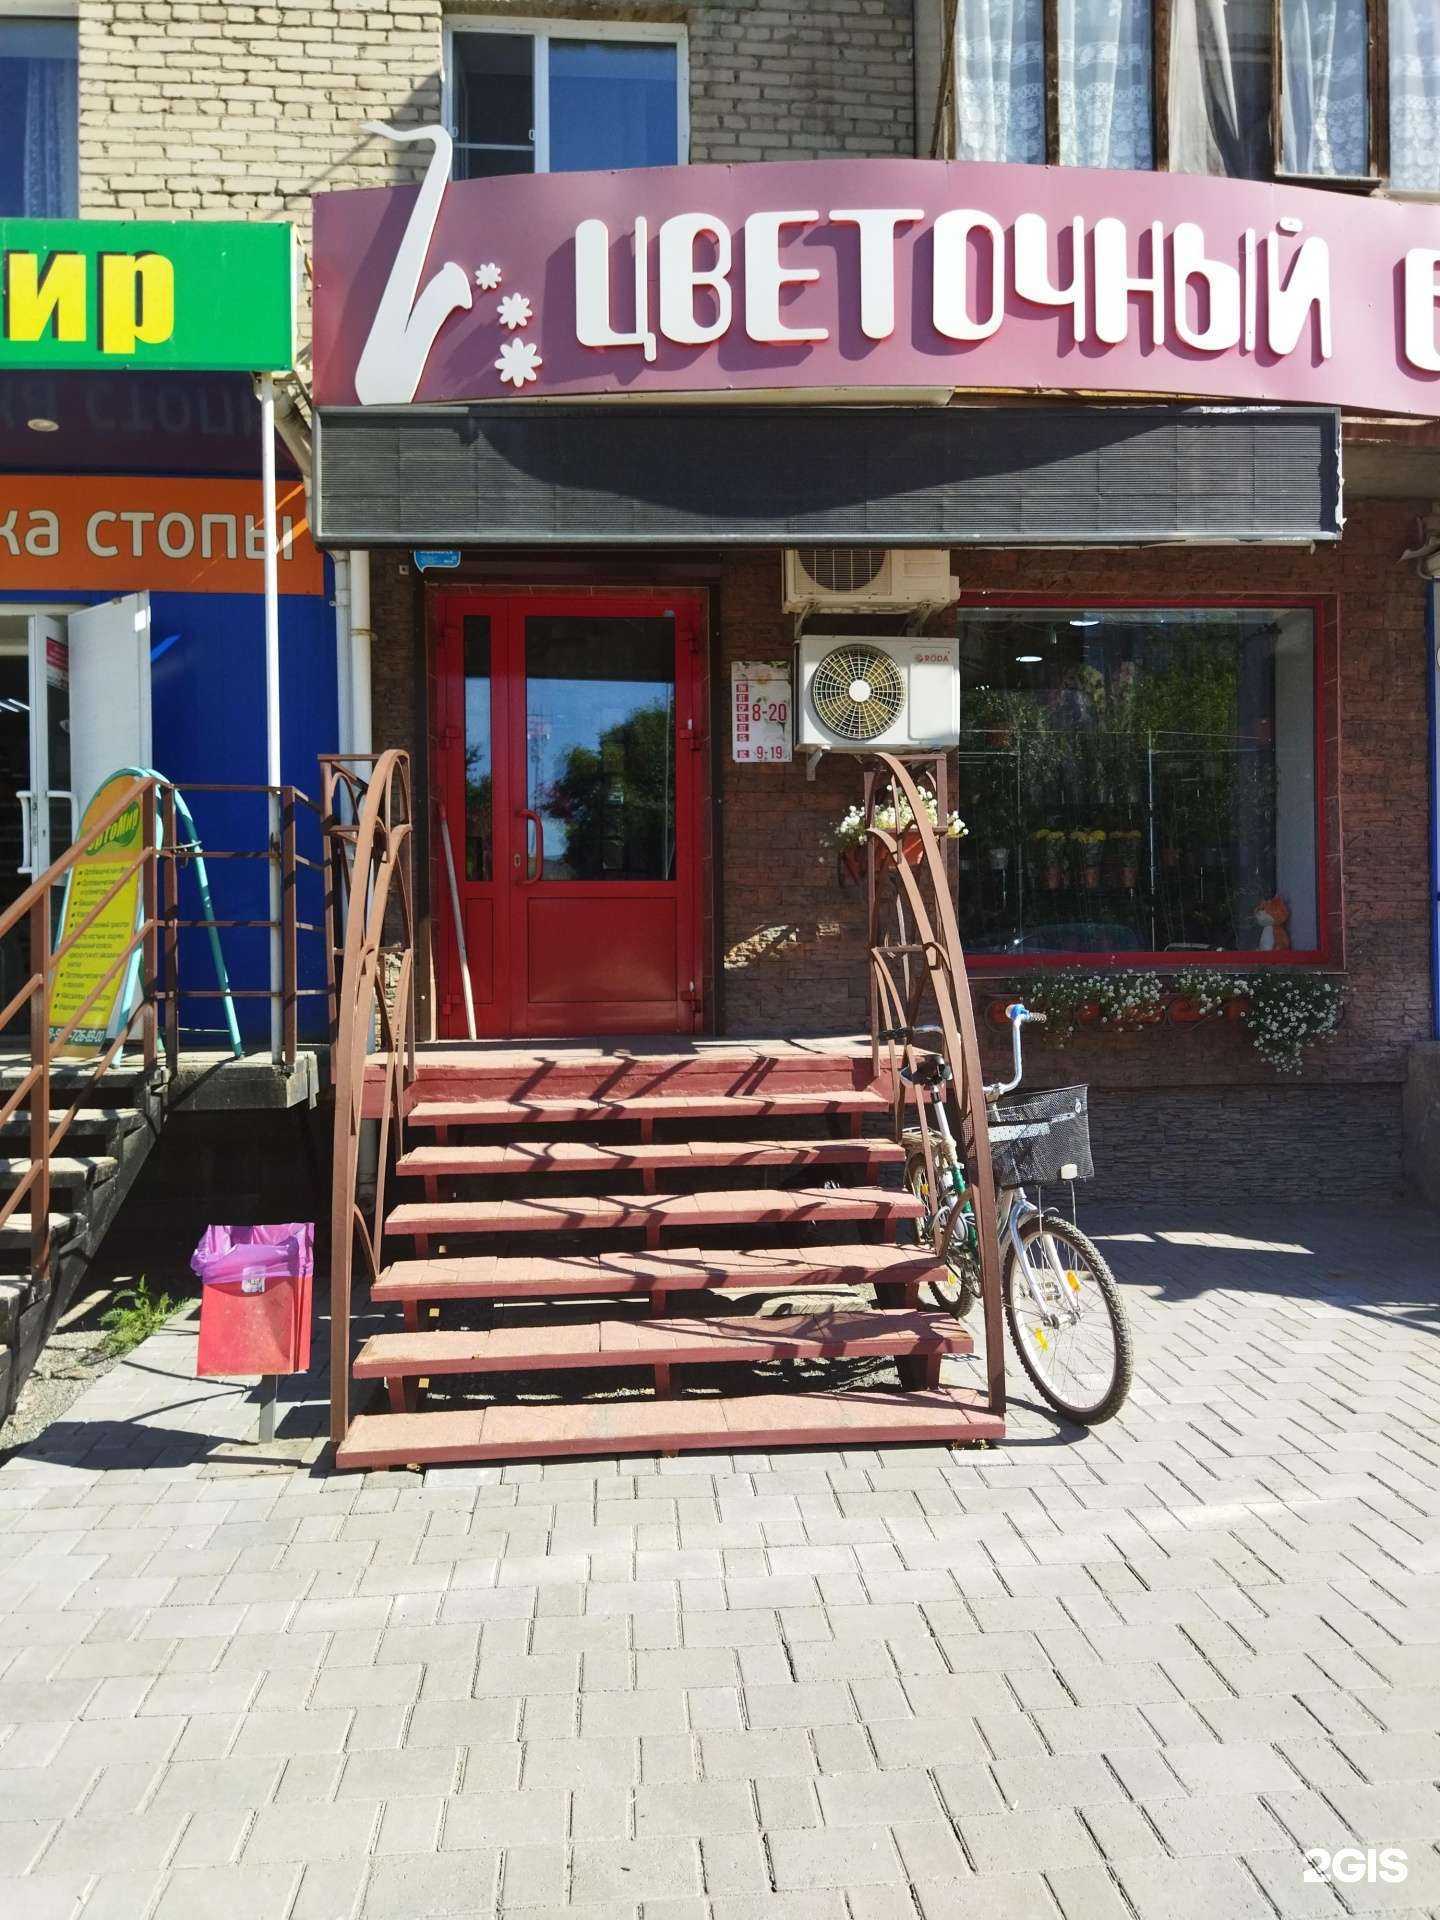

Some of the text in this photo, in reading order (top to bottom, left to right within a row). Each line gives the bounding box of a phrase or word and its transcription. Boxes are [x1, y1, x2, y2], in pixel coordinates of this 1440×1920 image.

[574, 207, 1333, 361] ЦВЕТОЧНЫЙ
[86, 510, 294, 562] стопы
[924, 654, 949, 663] RODA
[751, 703, 788, 722] 8-20
